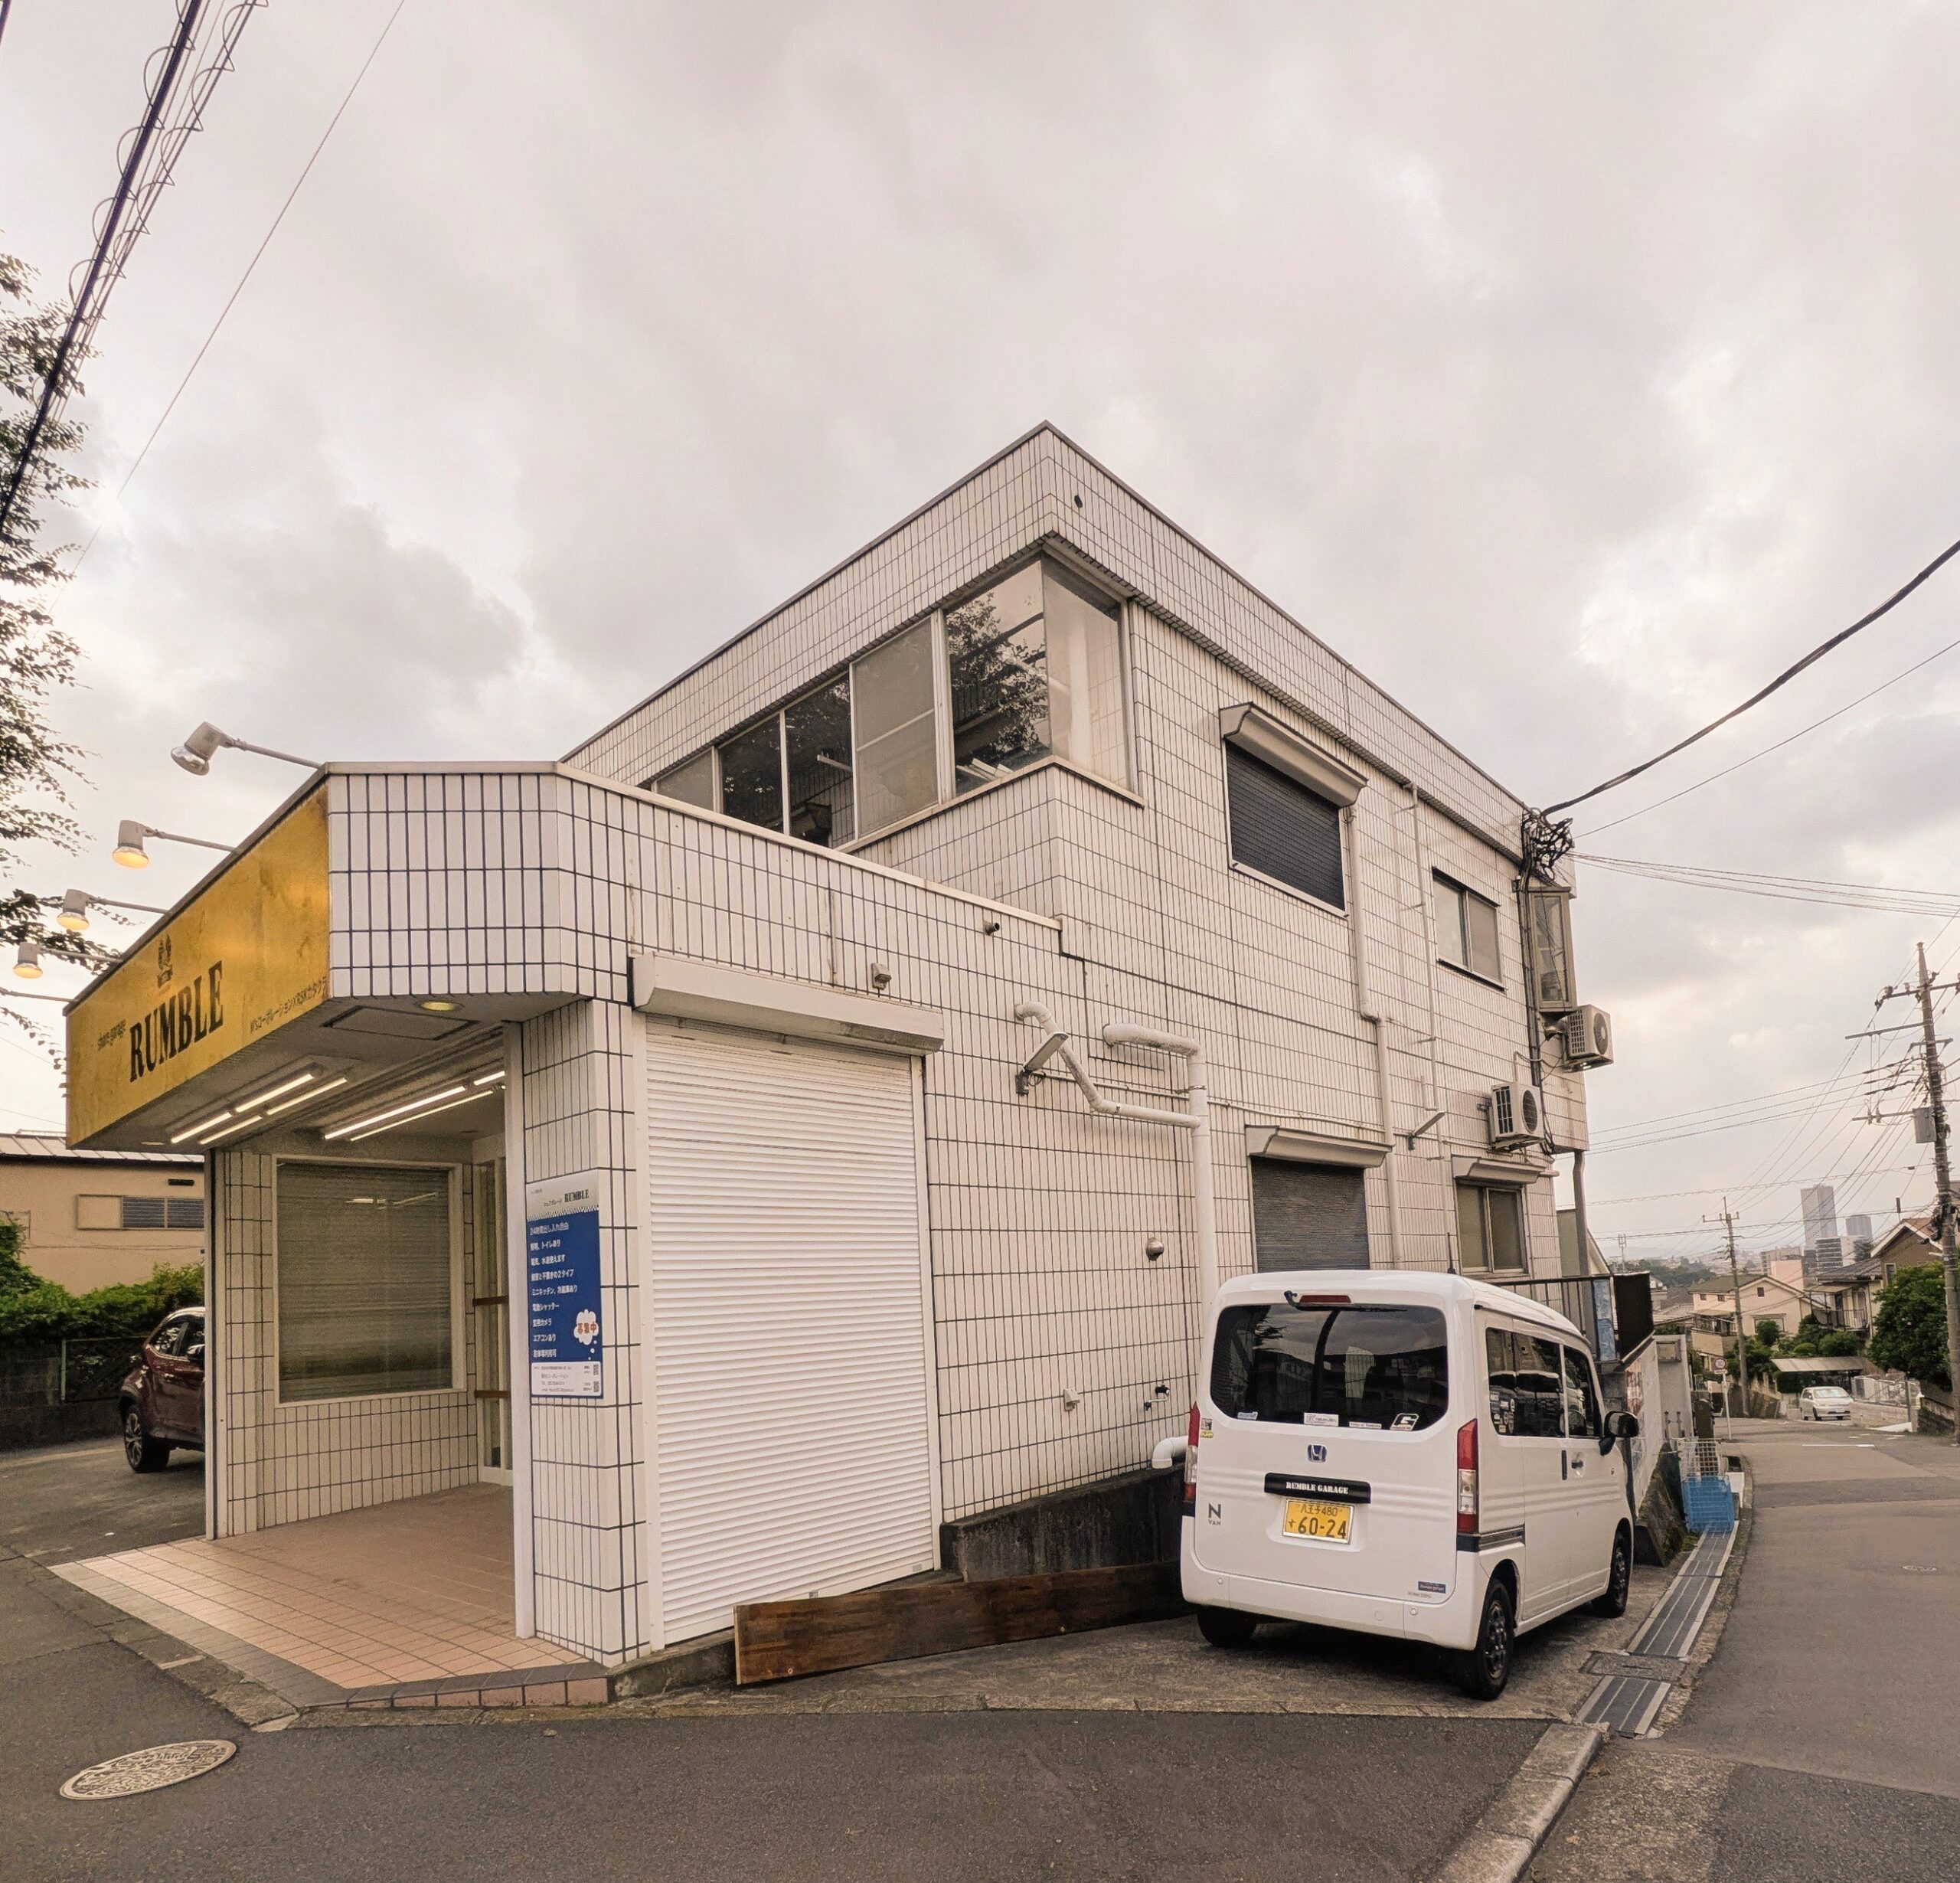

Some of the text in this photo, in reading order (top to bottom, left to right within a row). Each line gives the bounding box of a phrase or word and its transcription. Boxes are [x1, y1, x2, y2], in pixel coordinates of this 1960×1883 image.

[130, 960, 224, 1083] RUMBLE
[564, 1189, 589, 1203] RUMBLE
[577, 1322, 597, 1334] 募集中
[1286, 1482, 1348, 1494] RUMBLE GARAGE
[1208, 1502, 1221, 1519] N
[1298, 1517, 1347, 1539] 60-24
